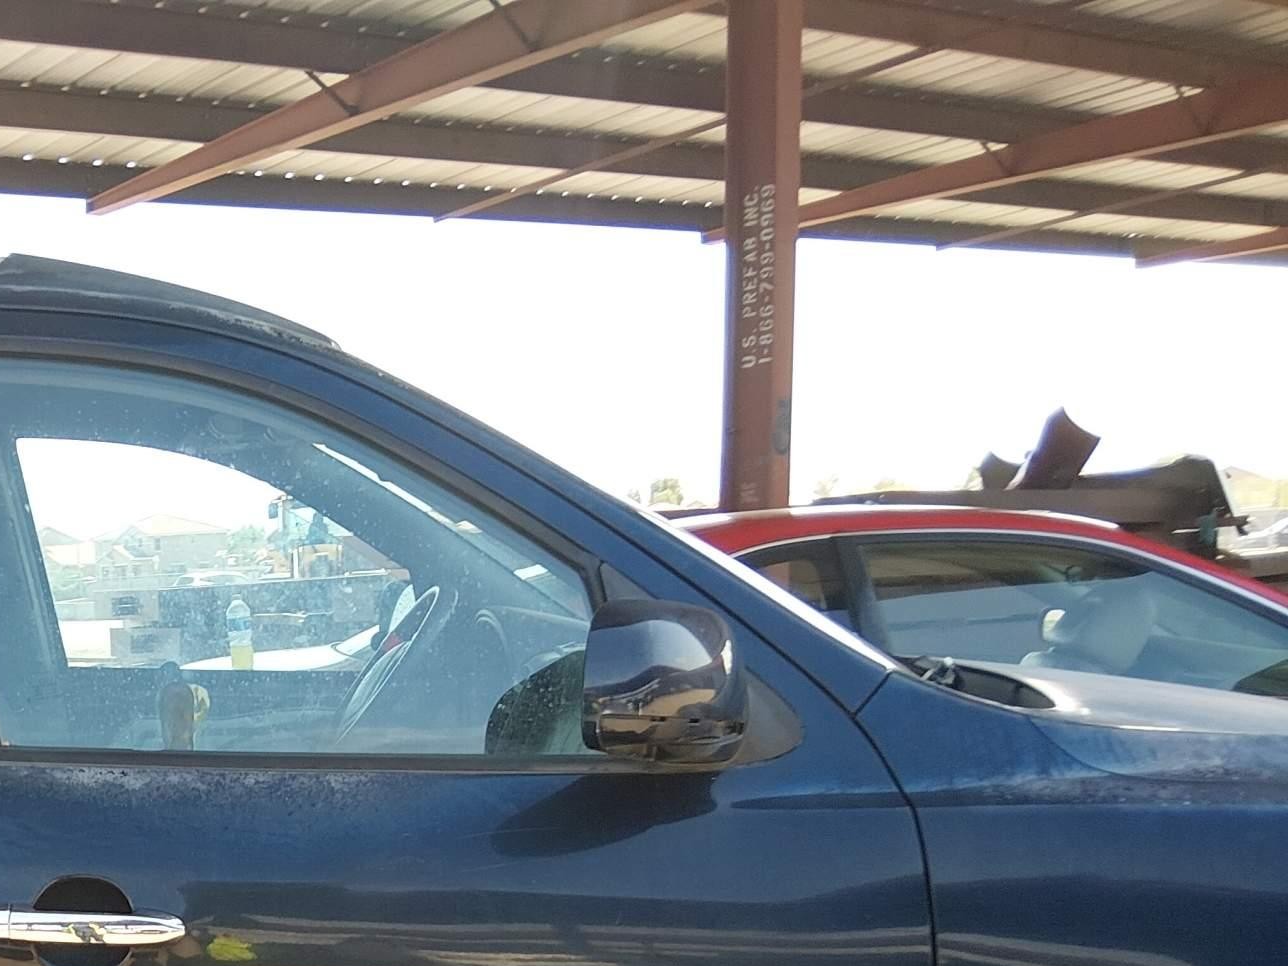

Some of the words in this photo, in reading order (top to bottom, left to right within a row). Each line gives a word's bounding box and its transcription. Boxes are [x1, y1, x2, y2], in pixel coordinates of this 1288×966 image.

[743, 186, 760, 227] INC.
[742, 237, 758, 318] PREFAB
[758, 184, 776, 364] 1-866-799-0969
[740, 328, 757, 368] U.S.
